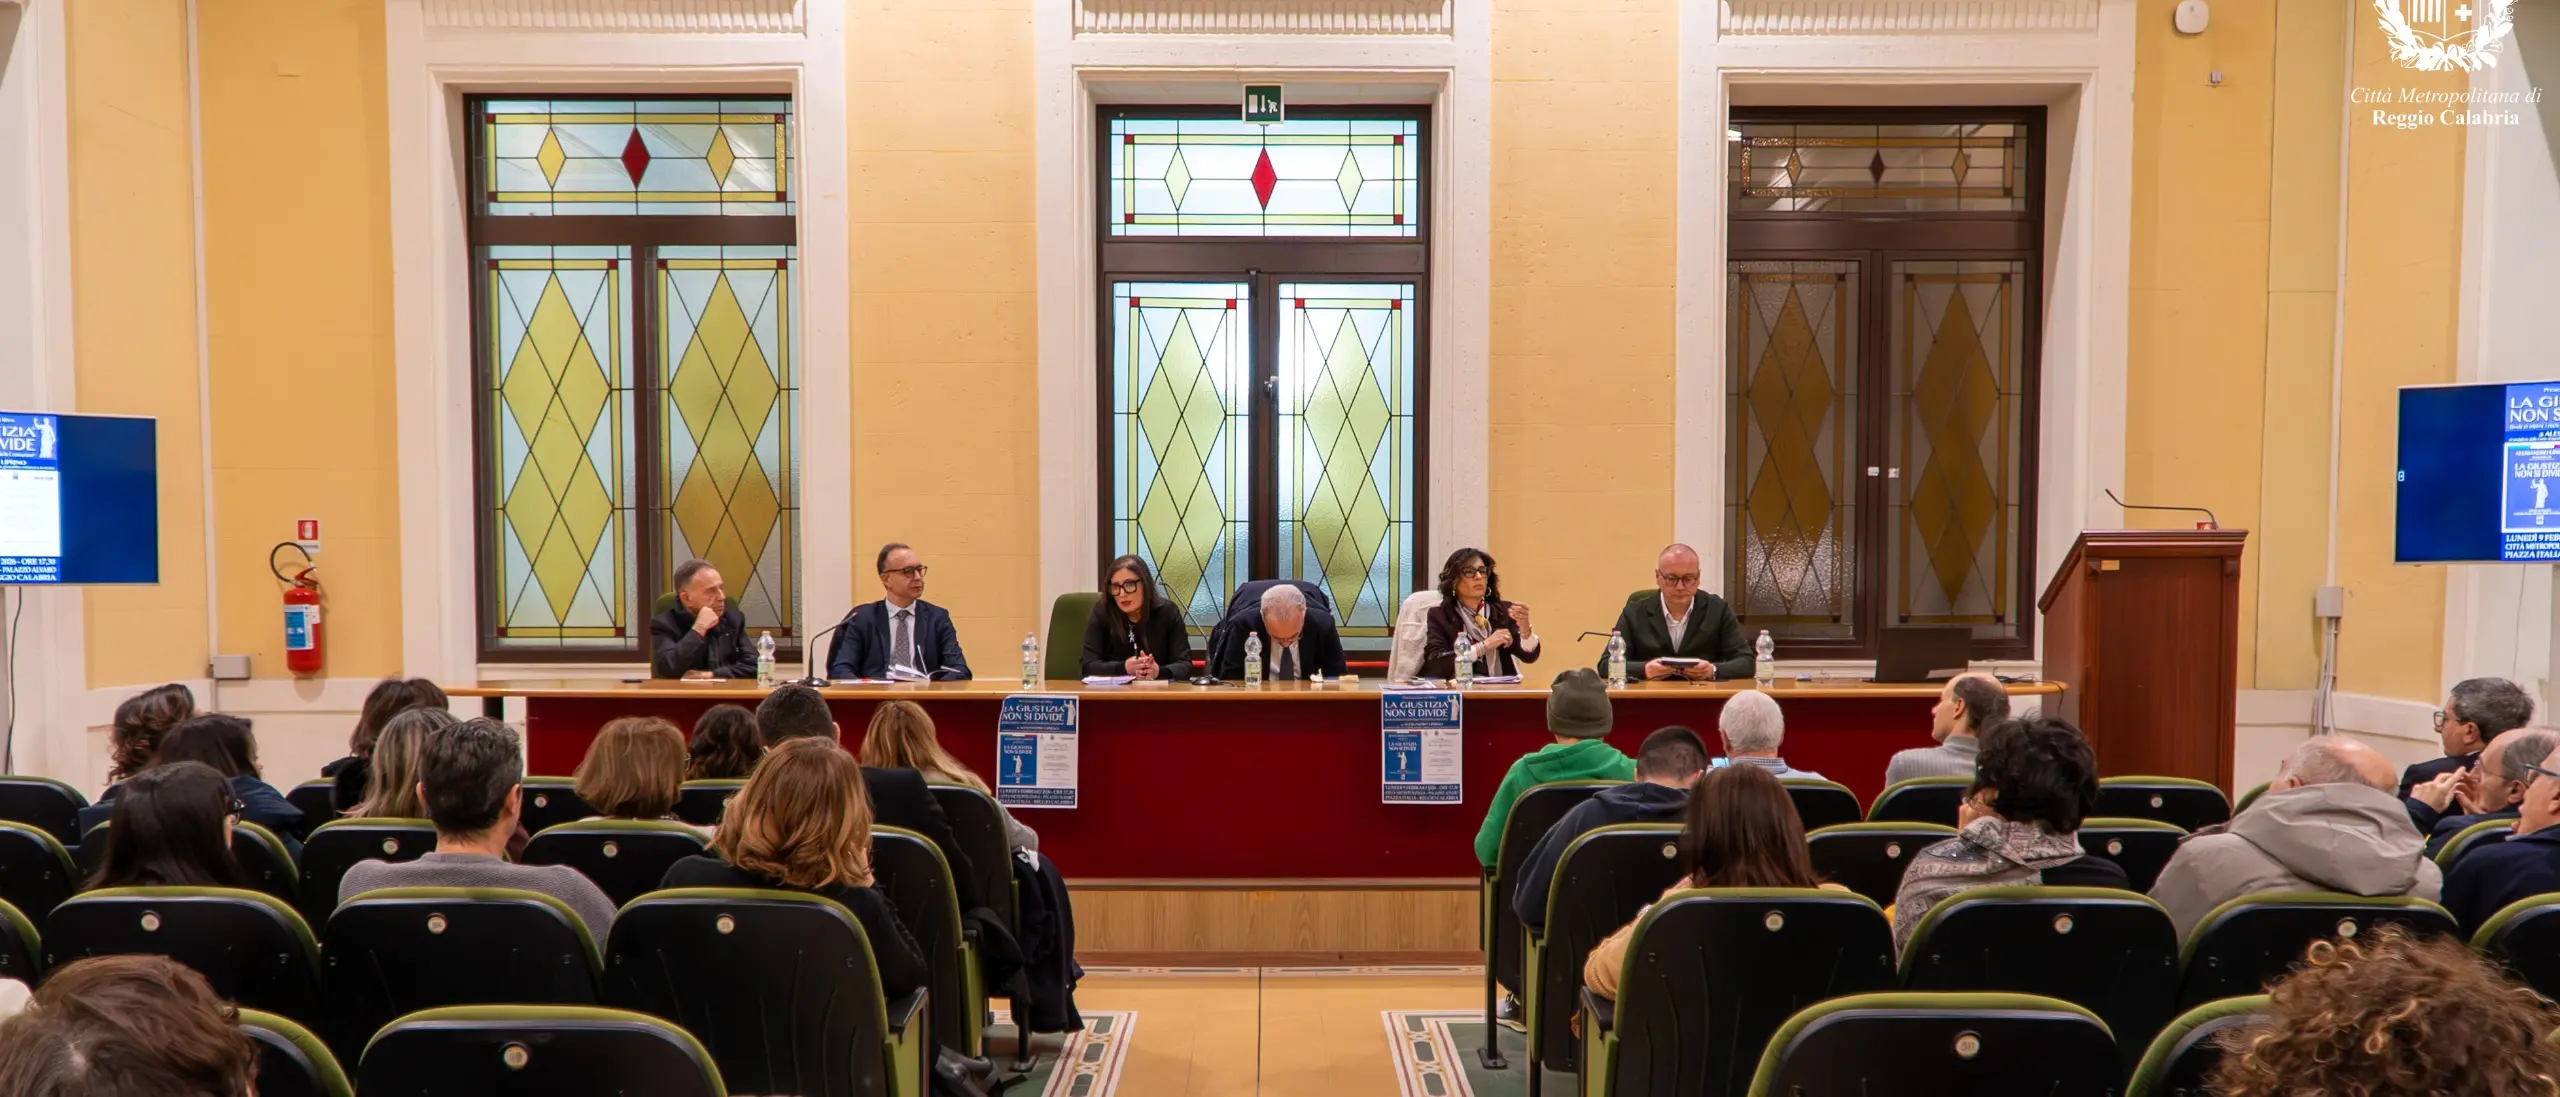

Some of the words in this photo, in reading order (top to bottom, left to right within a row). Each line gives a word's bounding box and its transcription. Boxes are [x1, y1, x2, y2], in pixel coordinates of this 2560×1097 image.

[2510, 397, 2533, 409] LA
[2510, 408, 2549, 423] NON
[2504, 550, 2536, 559] PIAZZA
[1015, 704, 1066, 713] GIUSTIZIA
[1399, 701, 1449, 709] GIUSTIZIA
[1024, 712, 1032, 720] SI
[1034, 712, 1065, 722] DIVIDE
[1384, 709, 1406, 717] NON
[1408, 709, 1416, 717] SI
[1418, 709, 1449, 717] DIVIDE
